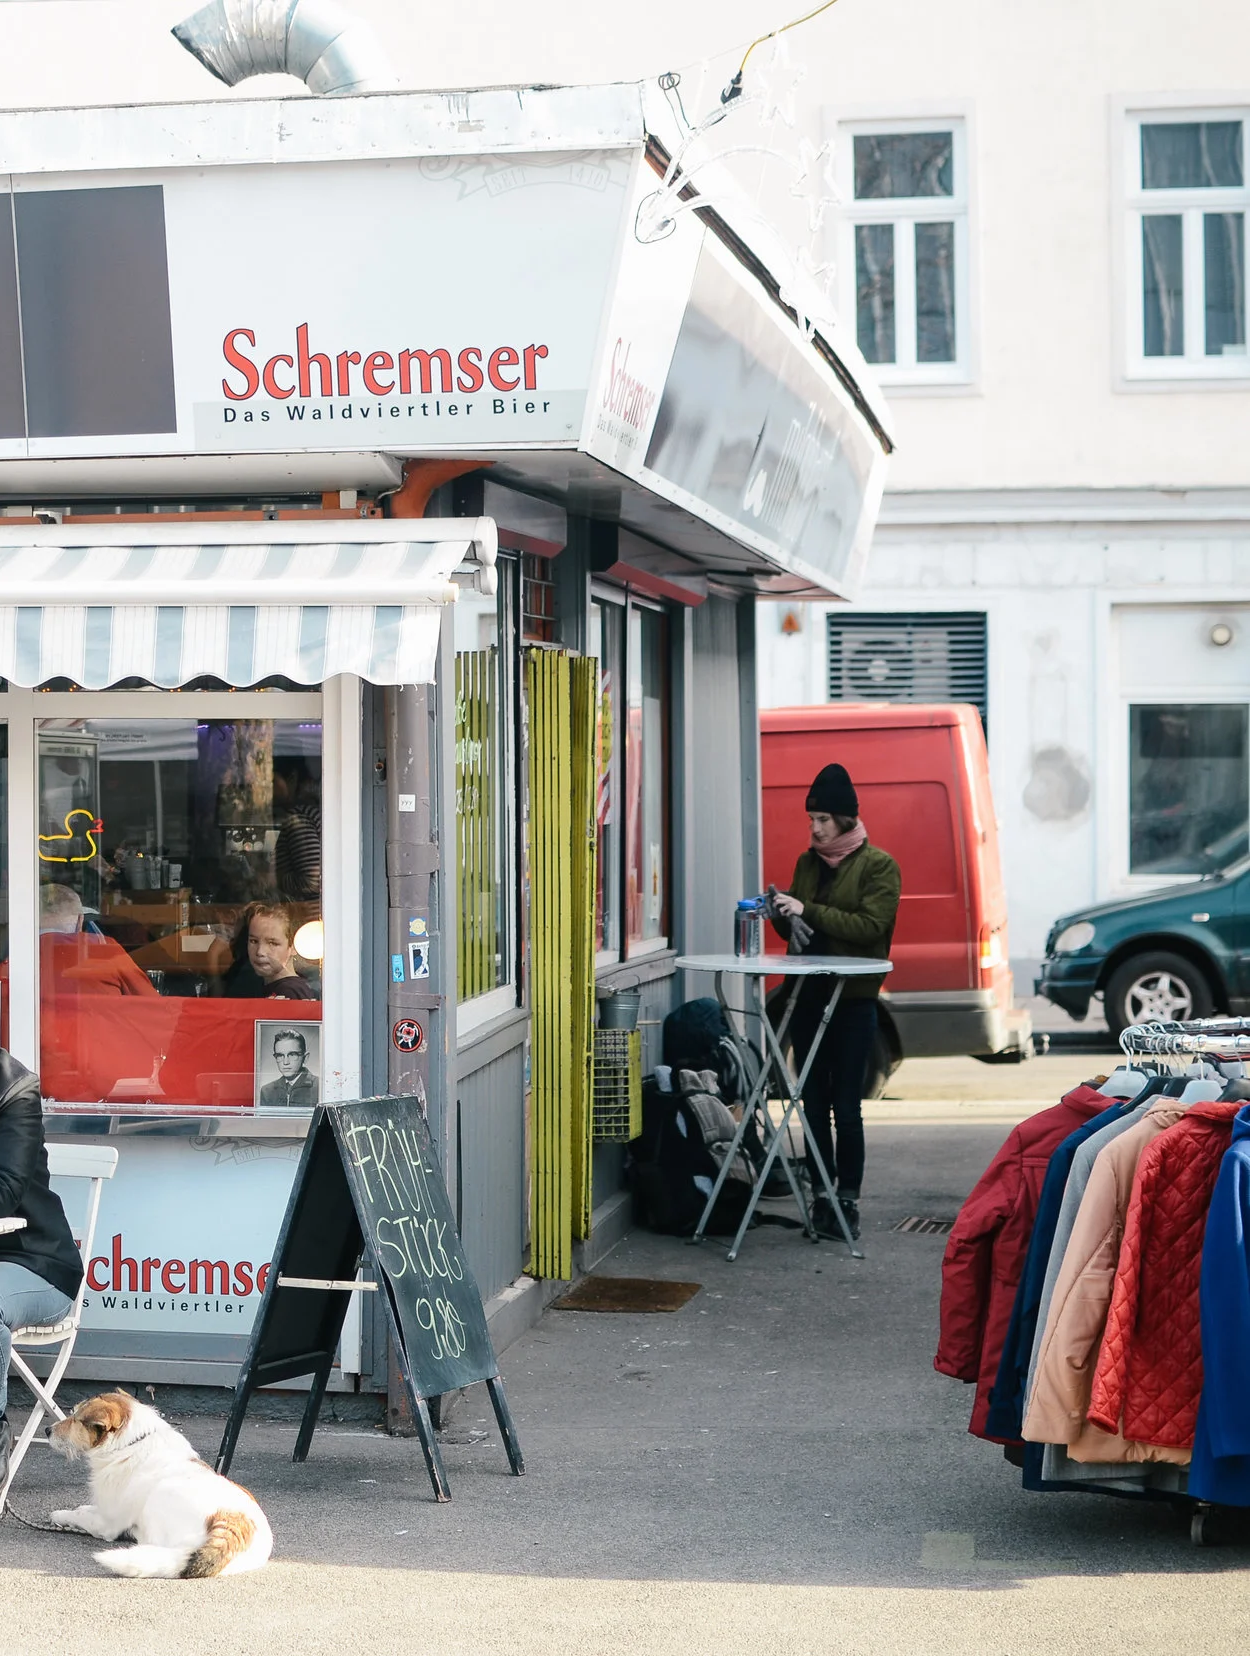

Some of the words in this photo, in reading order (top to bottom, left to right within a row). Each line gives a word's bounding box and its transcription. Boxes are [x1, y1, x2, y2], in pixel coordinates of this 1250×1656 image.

[222, 322, 549, 400] Schremser
[223, 407, 271, 423] Das
[287, 401, 473, 421] Waldviertler
[492, 398, 550, 415] Bier
[74, 1233, 271, 1296] chremse
[376, 1216, 463, 1284] STÜCK
[102, 1297, 245, 1313] Waldviertler
